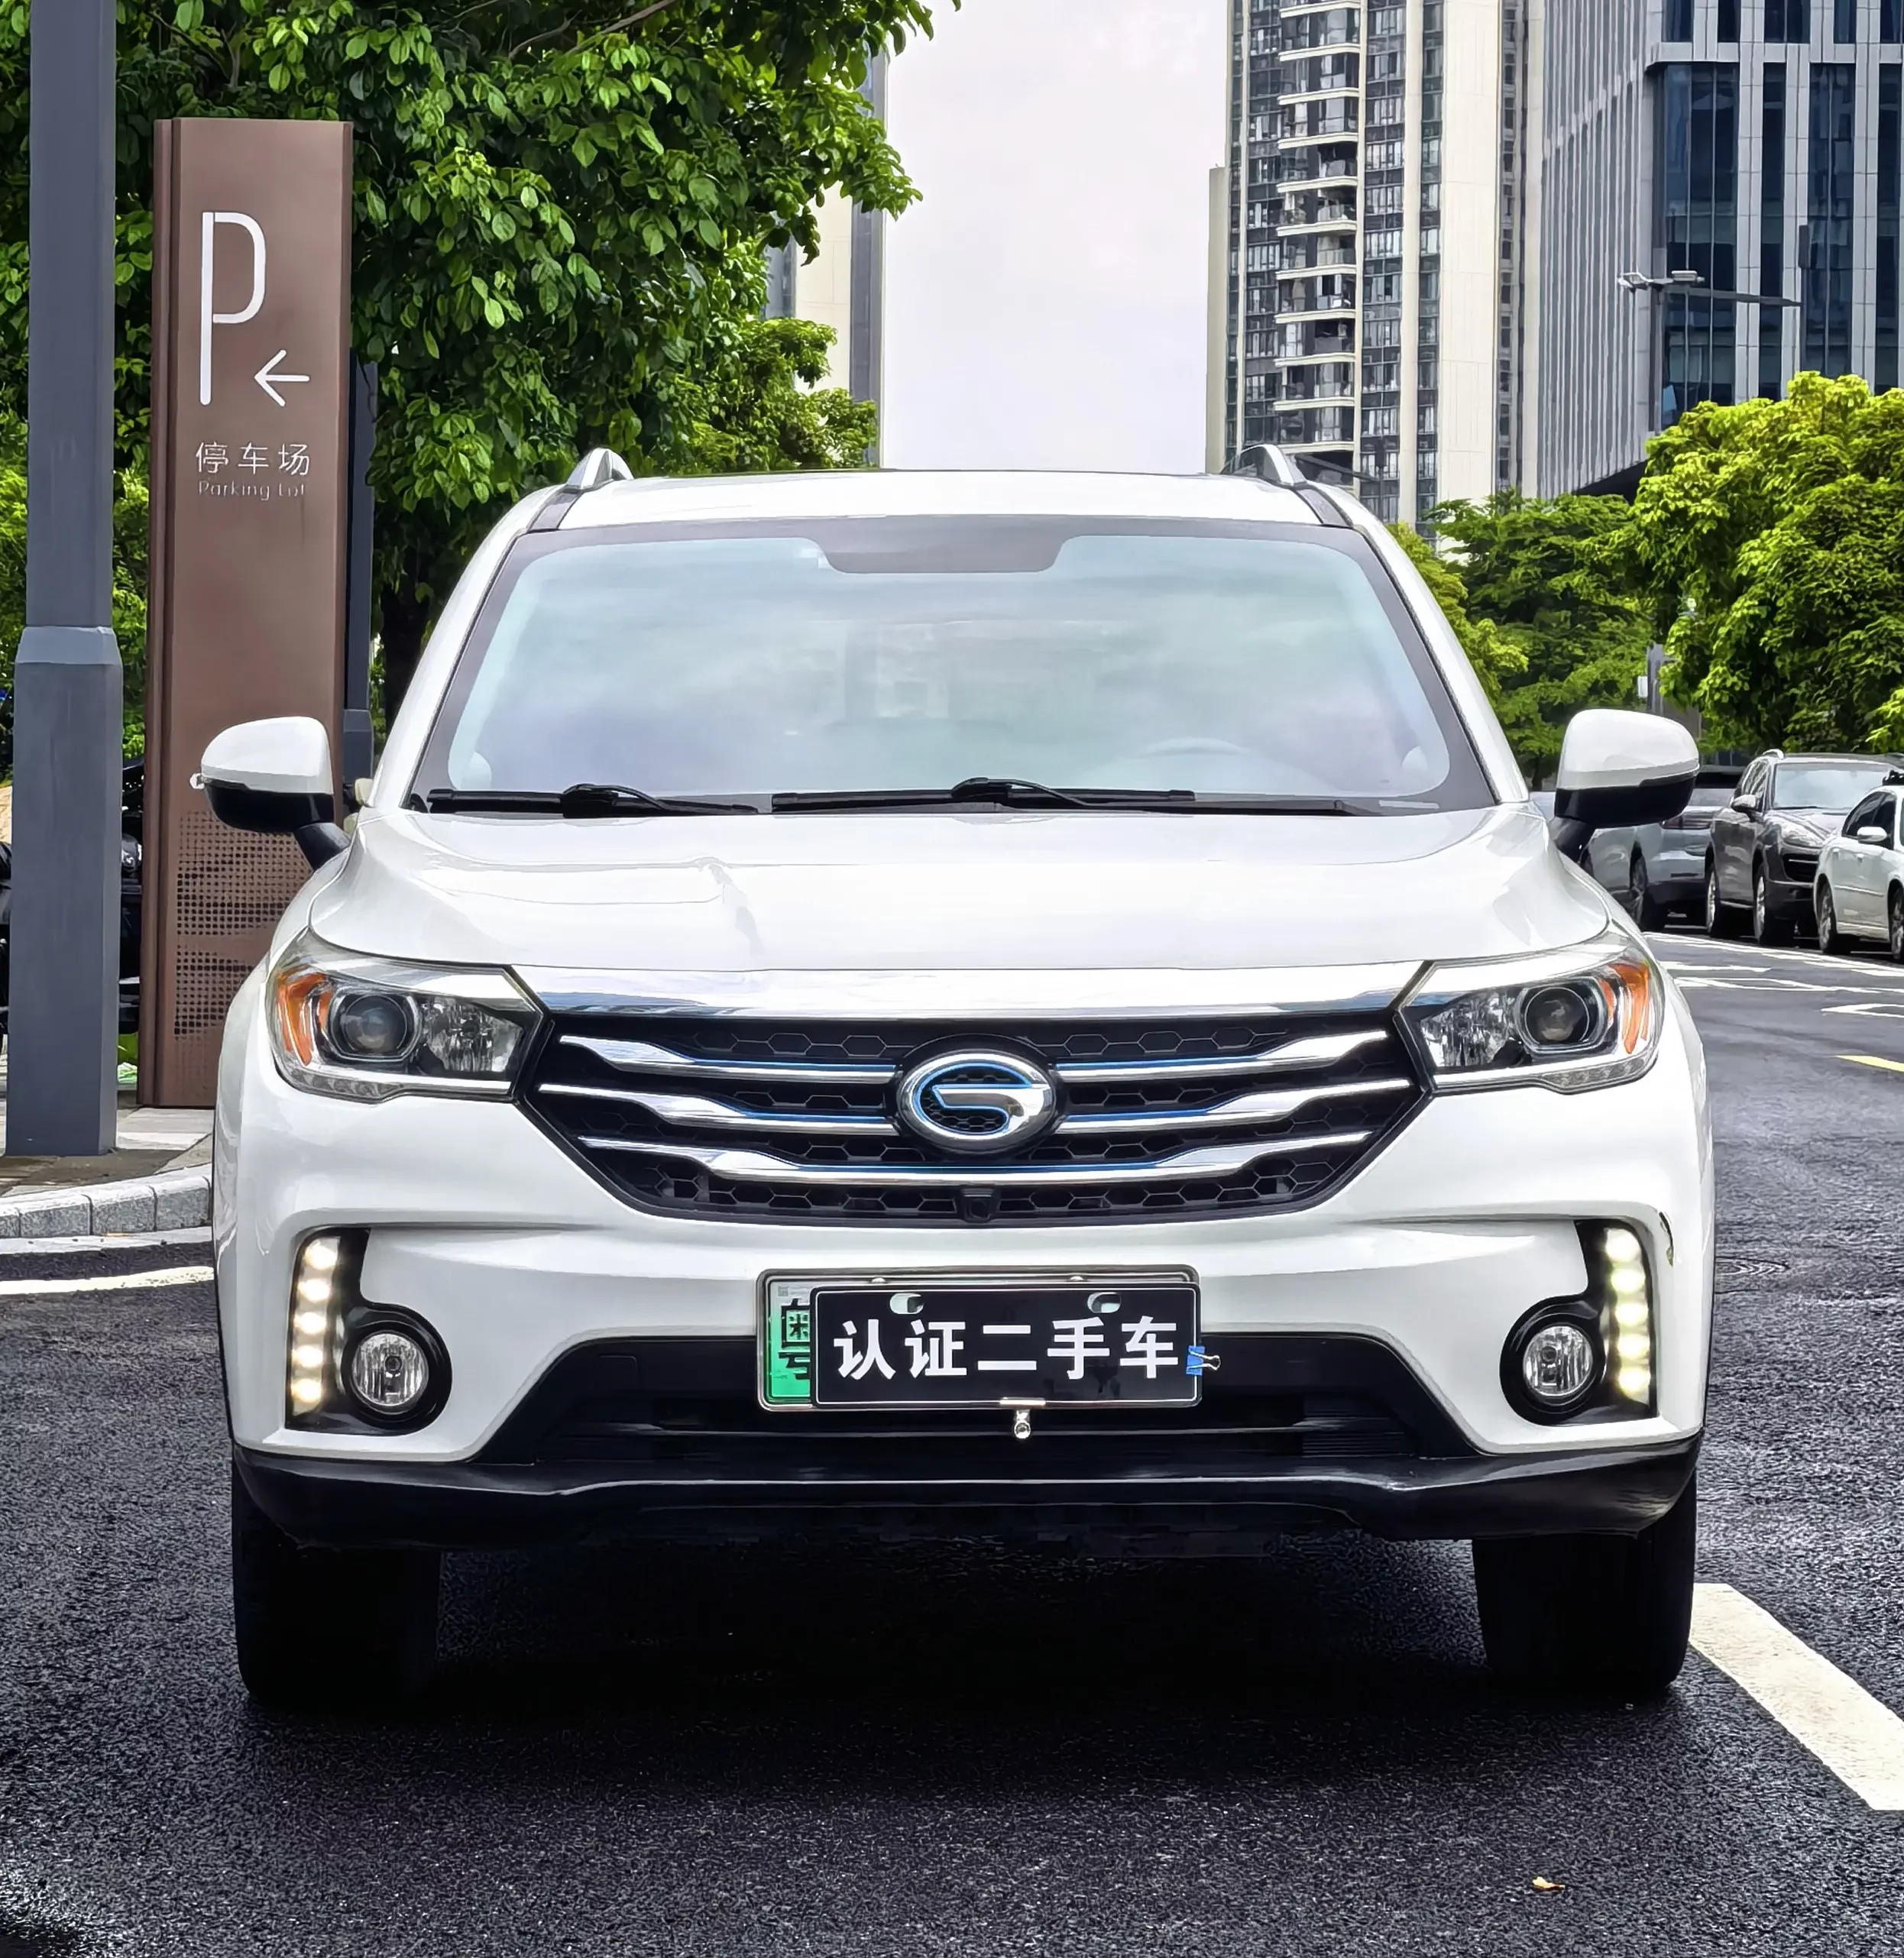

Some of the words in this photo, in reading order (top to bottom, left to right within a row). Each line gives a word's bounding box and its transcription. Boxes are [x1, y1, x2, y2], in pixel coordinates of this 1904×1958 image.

[200, 212, 266, 406] P
[196, 441, 310, 475] 停车场
[199, 481, 270, 500] Parking
[834, 1316, 1179, 1380] 认证二手车
